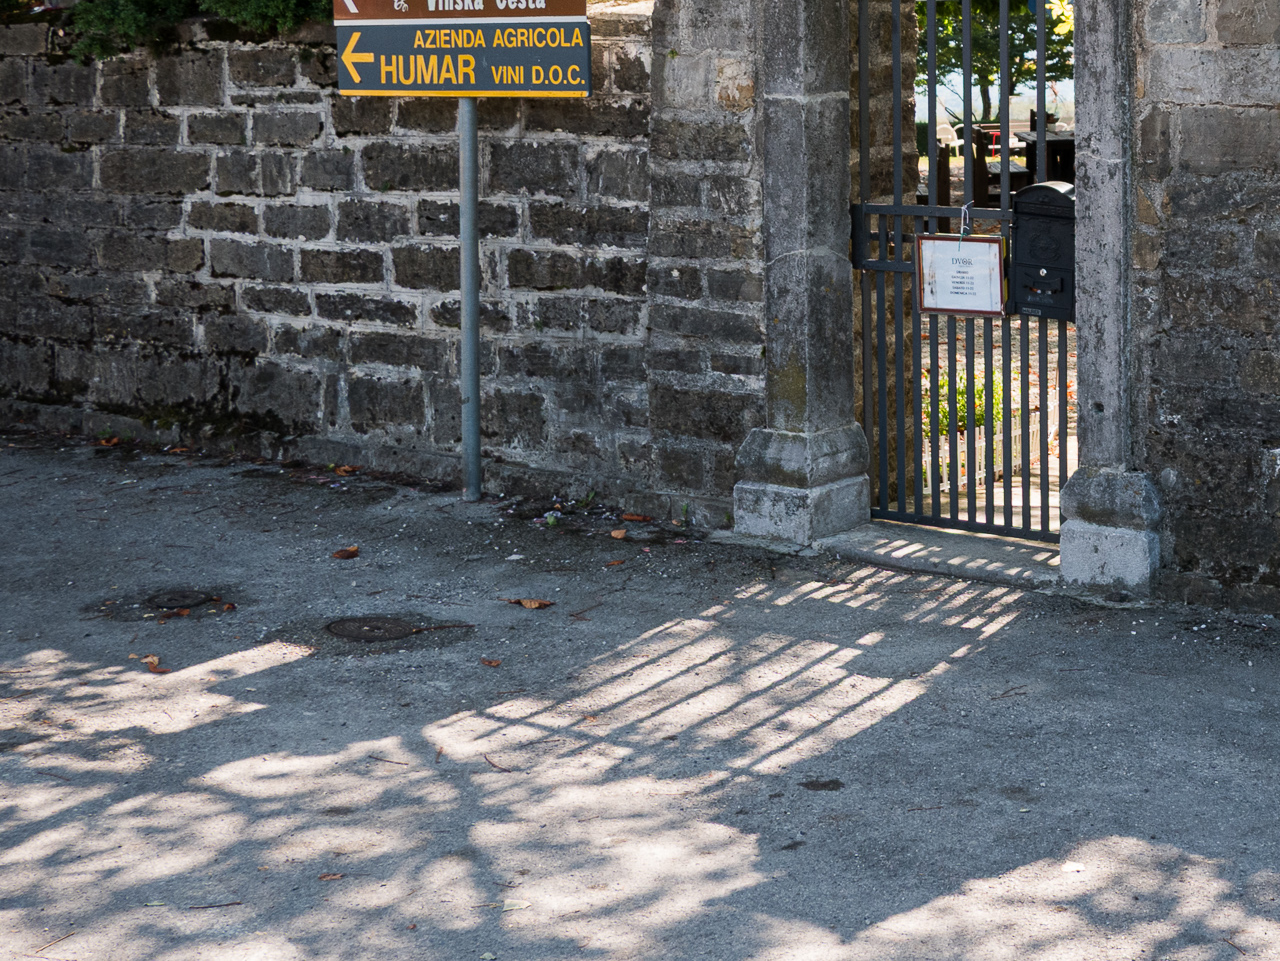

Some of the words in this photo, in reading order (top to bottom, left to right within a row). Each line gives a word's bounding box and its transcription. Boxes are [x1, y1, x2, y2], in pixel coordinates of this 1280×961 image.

[414, 30, 485, 48] AZIENDA
[493, 28, 583, 47] AGRICOLA
[381, 54, 475, 84] HUMAR
[491, 66, 523, 84] VINI
[532, 65, 585, 84] D.O.C.
[951, 257, 973, 265] DVOR
